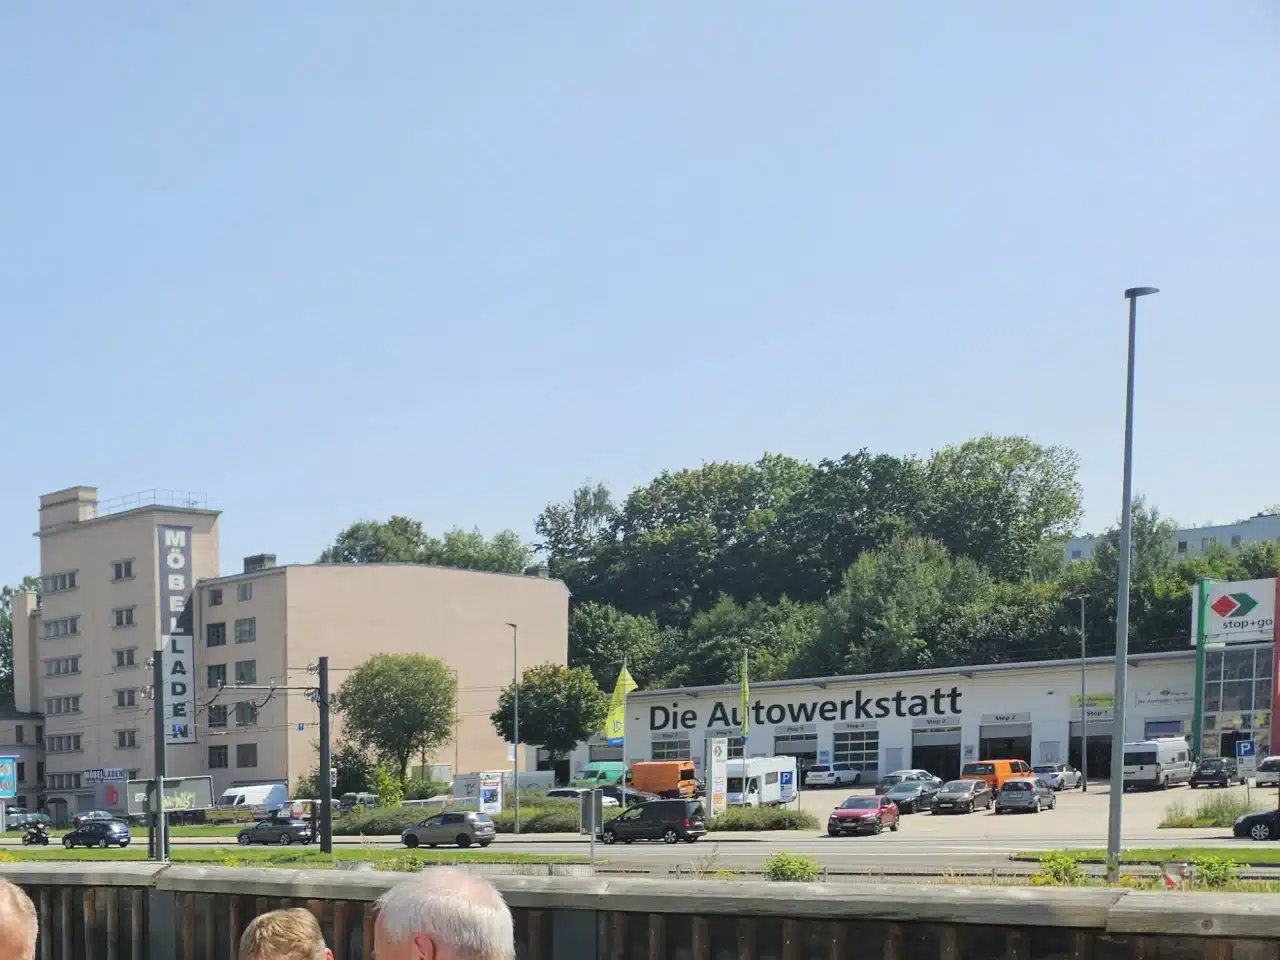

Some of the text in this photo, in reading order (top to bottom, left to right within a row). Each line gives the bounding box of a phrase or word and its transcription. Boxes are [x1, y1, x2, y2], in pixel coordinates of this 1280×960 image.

[1222, 618, 1273, 629] stop+go
[649, 686, 963, 731] Die Autowerkstatt
[1241, 743, 1250, 755] P
[782, 773, 791, 783] P
